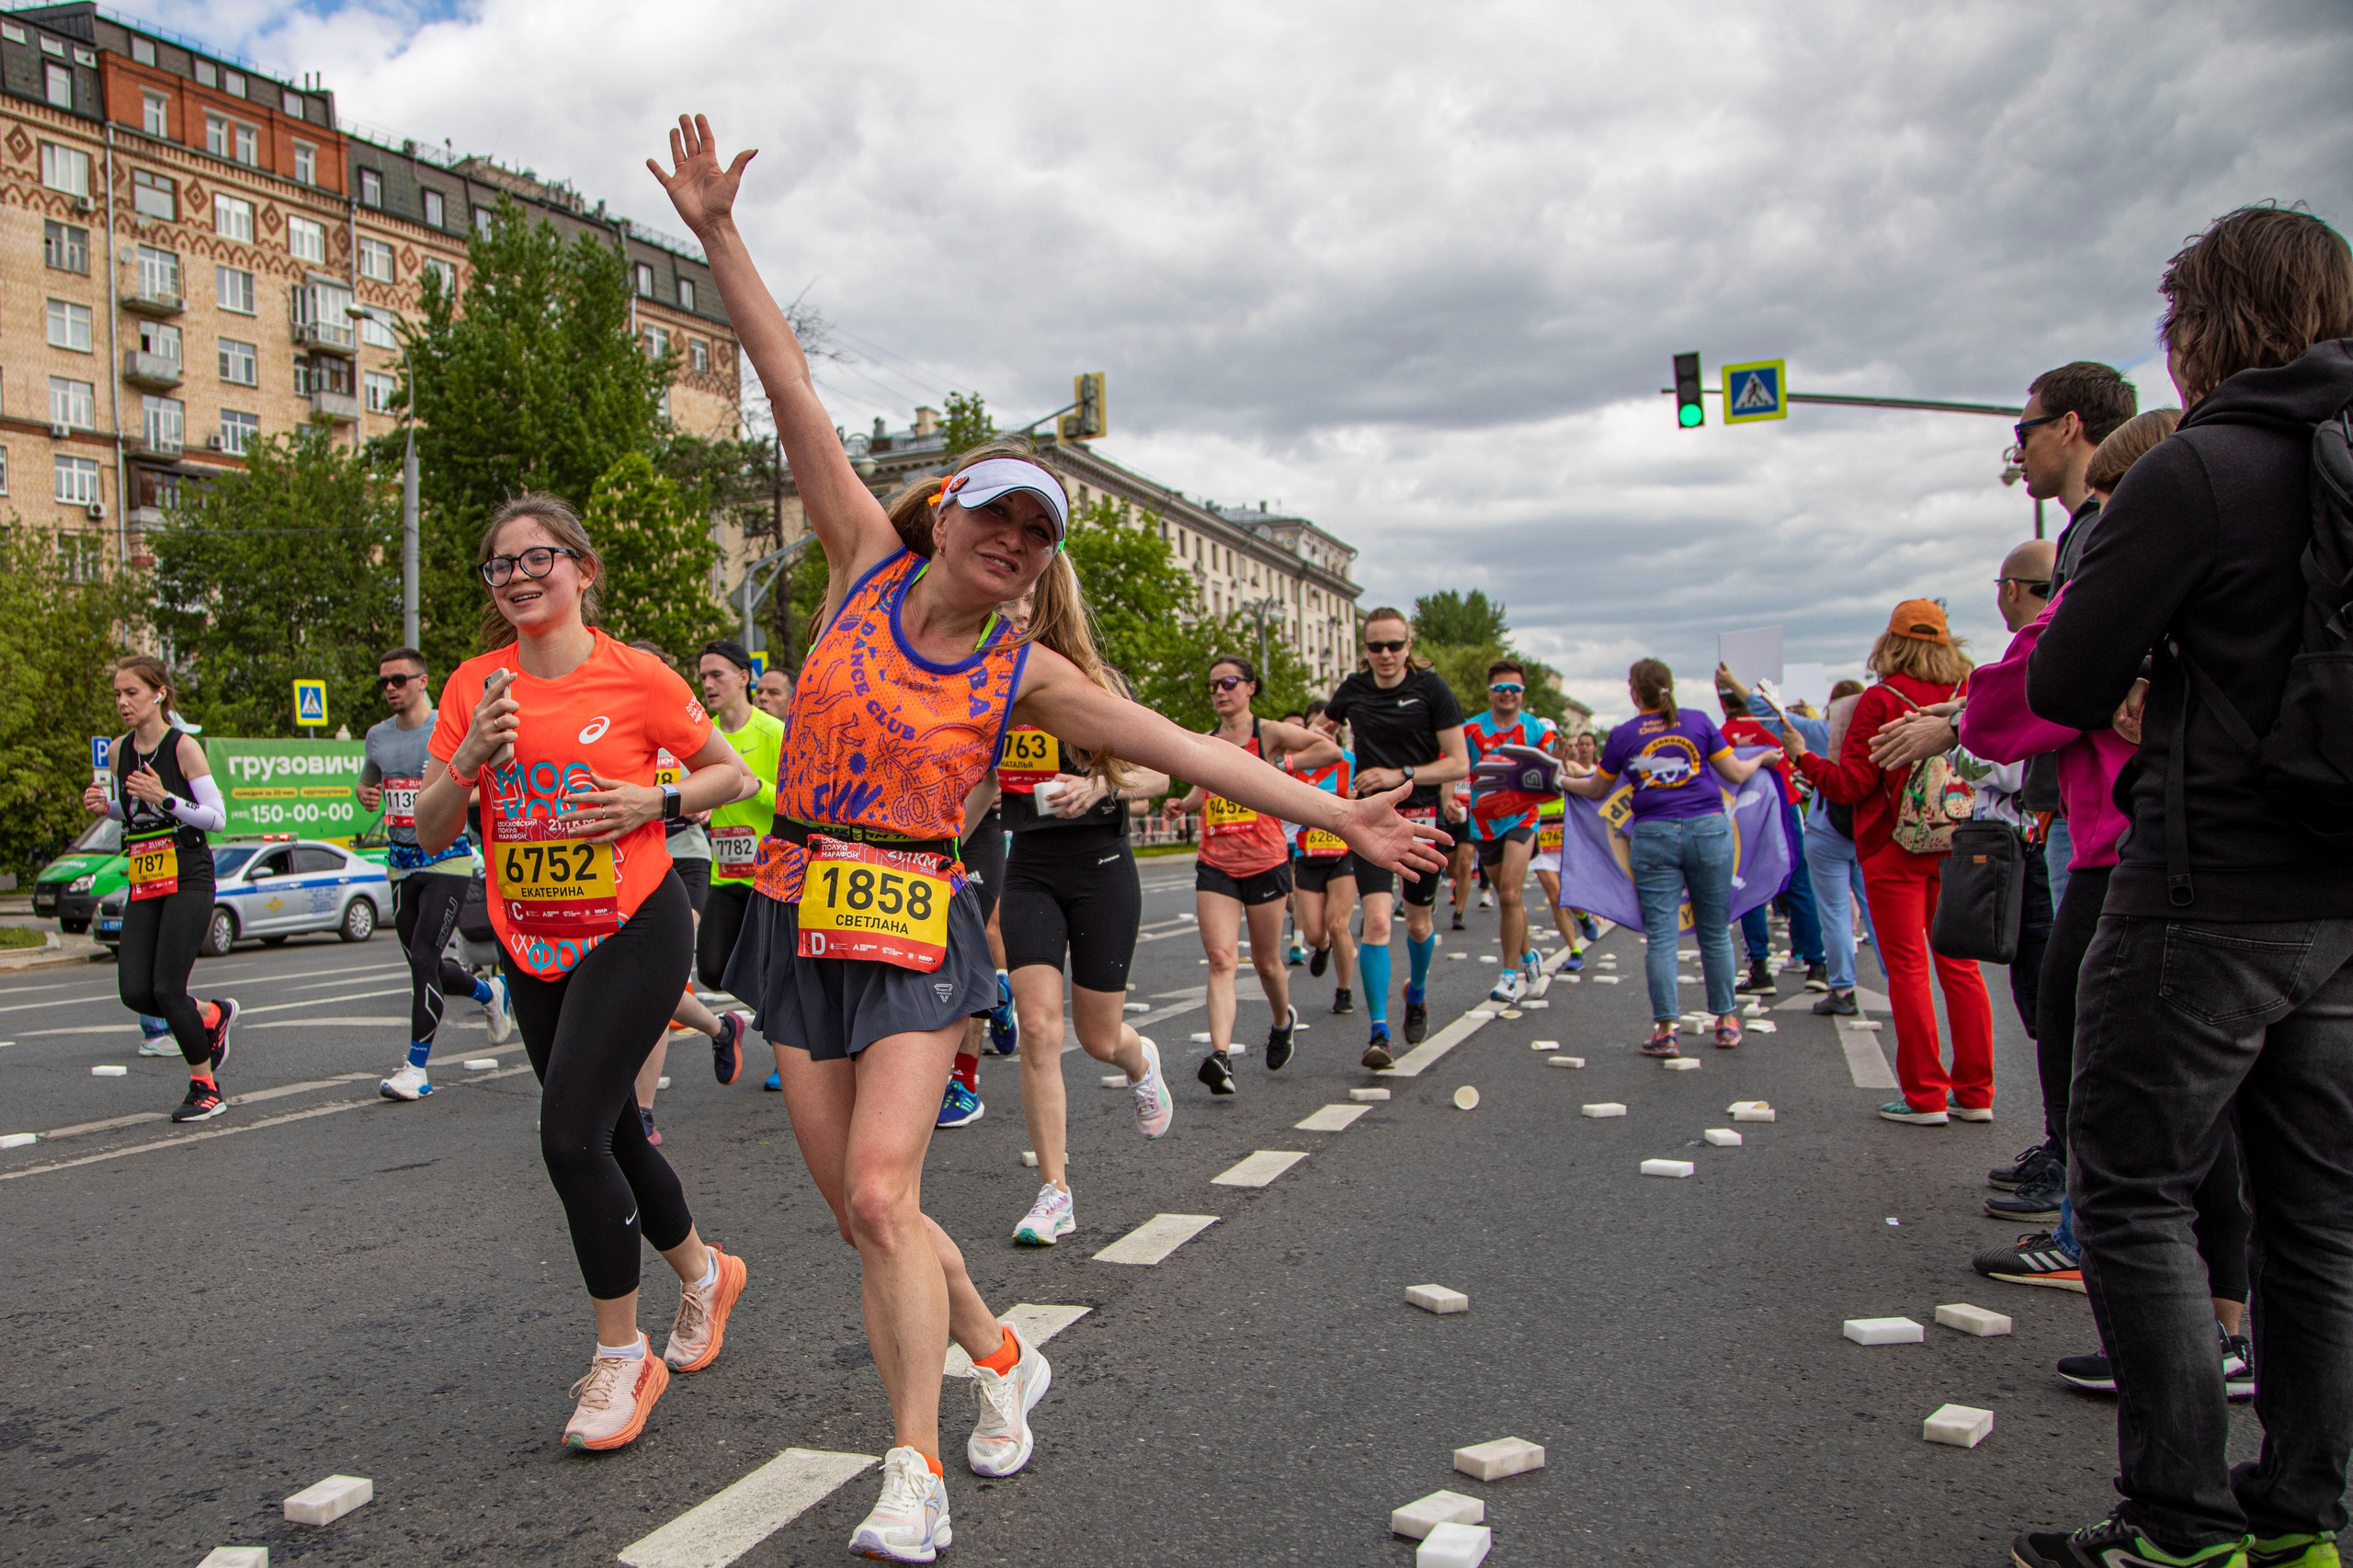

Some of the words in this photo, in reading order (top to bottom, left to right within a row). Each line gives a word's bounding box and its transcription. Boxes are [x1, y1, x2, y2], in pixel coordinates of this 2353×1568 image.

[850, 619, 876, 697] DANCE
[866, 699, 916, 740] CLUB
[97, 741, 108, 766] P
[1004, 733, 1047, 759] 763
[1000, 760, 1034, 768] НАТАЛЬЯ
[495, 761, 591, 796] МОС
[251, 802, 353, 824] 150-00-00
[497, 819, 538, 827] МОСКОВСКИЙ
[716, 838, 753, 856] 7782
[134, 853, 164, 874] 787
[506, 844, 597, 883] 6752
[919, 866, 937, 876] 2023
[521, 886, 585, 898] ЕКАТЕРИНА
[822, 867, 933, 921] 1858
[835, 915, 909, 935] СВЕТЛАНА
[811, 932, 826, 955] D
[631, 1359, 653, 1404] HOKA
